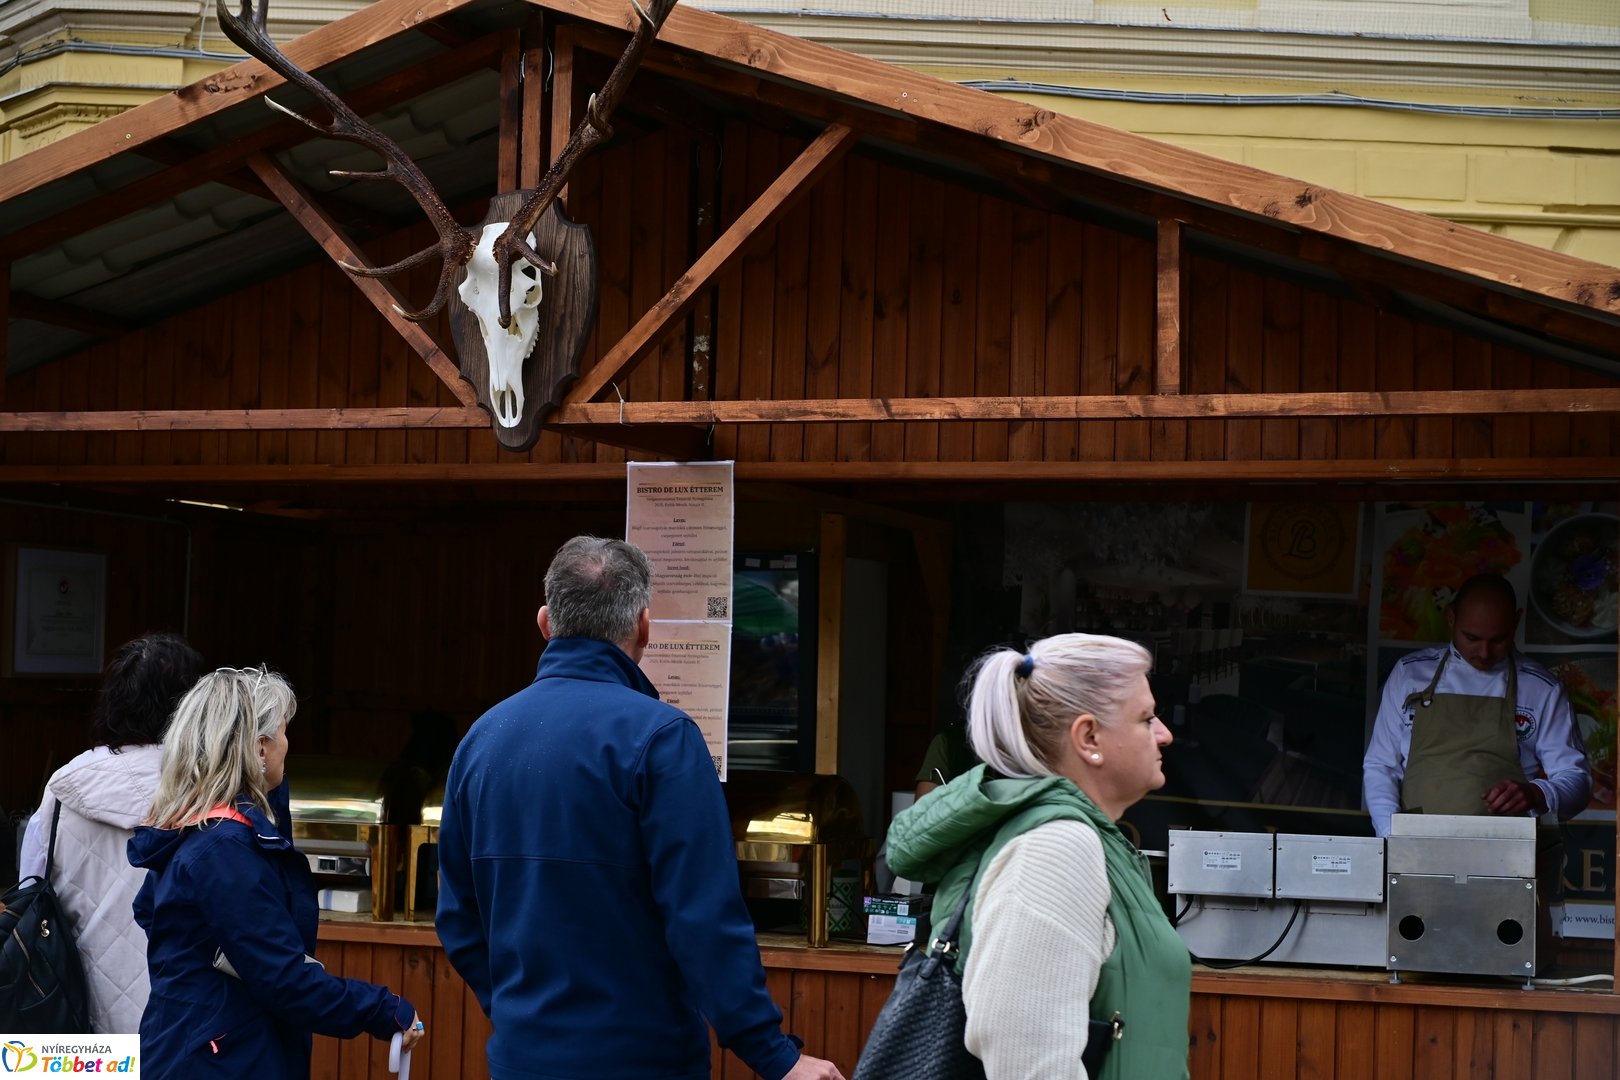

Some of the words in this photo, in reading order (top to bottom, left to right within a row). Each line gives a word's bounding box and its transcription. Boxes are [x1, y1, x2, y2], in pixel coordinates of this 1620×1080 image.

[637, 486, 662, 494] BISTRO
[690, 485, 723, 493] ÉTTEREM
[686, 642, 720, 651] ÉTTEREM
